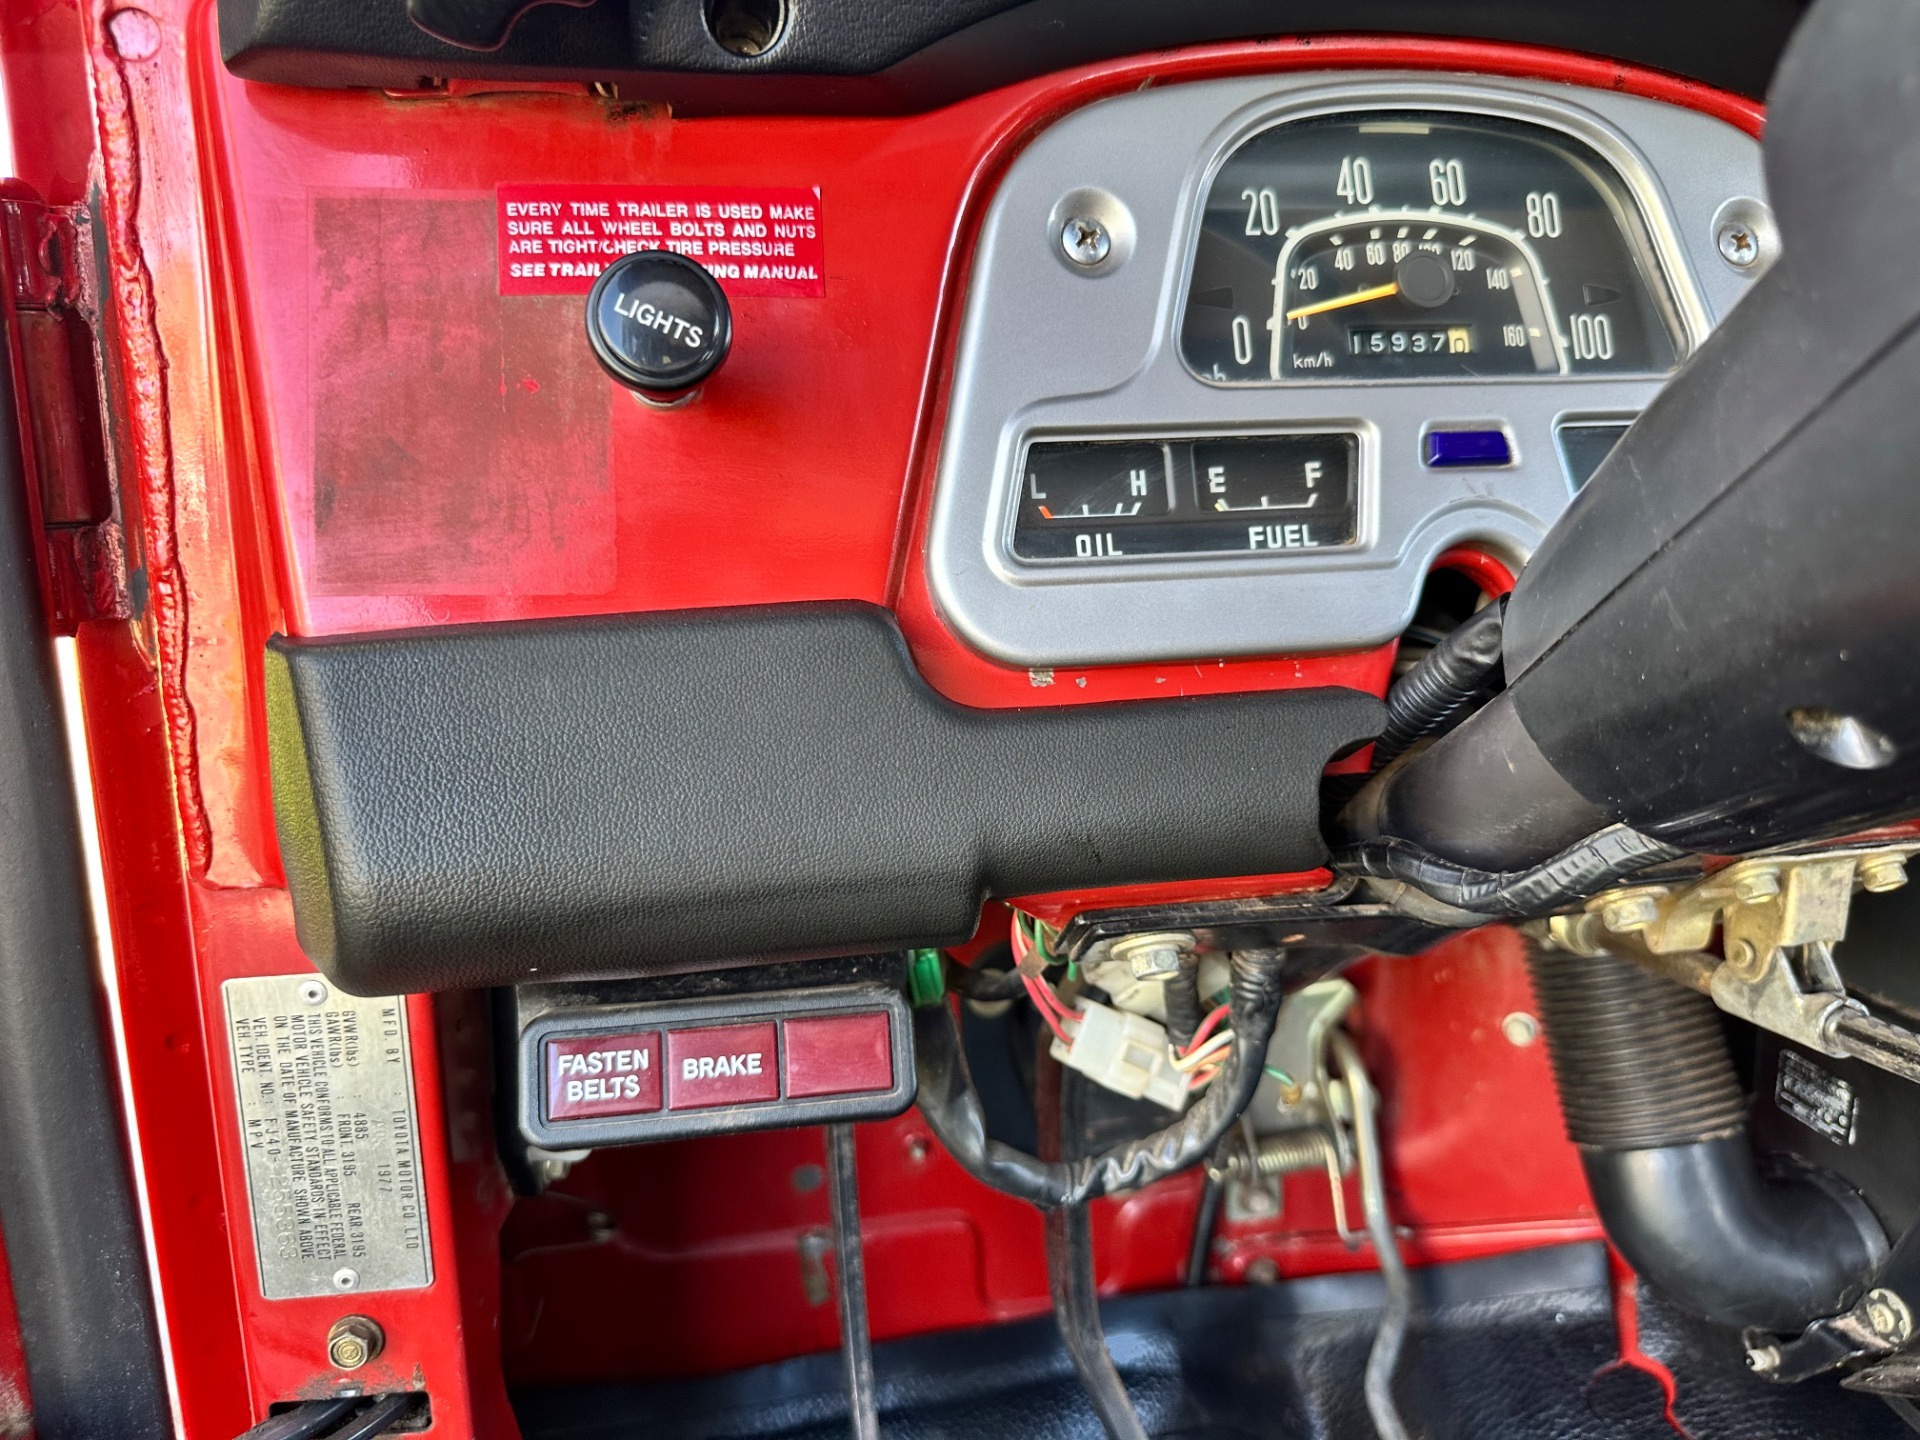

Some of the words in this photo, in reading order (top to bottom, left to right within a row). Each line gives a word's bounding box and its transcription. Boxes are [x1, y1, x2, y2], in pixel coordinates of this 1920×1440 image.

[1337, 158, 1373, 205] 40
[1429, 159, 1467, 206] 60
[506, 202, 562, 217] EVERY
[570, 202, 610, 217] TIME
[617, 203, 689, 218] TRAILER
[695, 204, 712, 218] IS
[718, 204, 763, 219] USED
[769, 205, 816, 221] MAKE
[1241, 188, 1280, 236] 20
[1526, 192, 1562, 238] 80
[507, 221, 554, 235] SURE
[561, 221, 595, 236] ALL
[602, 221, 663, 236] WHEEL
[669, 222, 725, 237] BOLTS
[732, 223, 768, 238] AND
[774, 223, 816, 239] NUTS
[508, 240, 544, 254] ARE
[548, 239, 661, 254] TIGHT/CHECK
[665, 241, 705, 255] TIRE
[708, 241, 795, 257] PRESSURE
[1334, 249, 1353, 271] 40
[1366, 244, 1384, 265] 60
[1392, 243, 1409, 264] 80
[1451, 249, 1473, 271] 120
[510, 263, 546, 277] SEE
[549, 263, 609, 278] TRAIL
[744, 265, 818, 280] MANUAL
[1298, 270, 1316, 290] 20
[1486, 269, 1508, 290] 140
[613, 292, 704, 349] LIGHTS
[1232, 316, 1252, 365] 0
[1503, 326, 1525, 347] 160
[1570, 315, 1613, 361] 100
[1293, 353, 1333, 369] km/h
[1030, 473, 1047, 499] L
[1130, 470, 1147, 496] H
[1208, 467, 1226, 493] E
[1304, 462, 1322, 488] F
[1075, 533, 1123, 557] OIL
[1248, 524, 1319, 550] FUEL
[235, 1018, 251, 1041] VEH.
[252, 1017, 268, 1040] VEH.
[273, 1015, 288, 1028] ON
[290, 1014, 307, 1049] MOTOR
[306, 1013, 322, 1034] THIS
[381, 1007, 398, 1040] MFD.
[275, 1036, 291, 1054] THE
[309, 1038, 327, 1076] VEHICLE
[385, 1047, 400, 1063] BY
[238, 1045, 255, 1073] TYPE
[255, 1044, 272, 1077] IDENT.
[558, 1049, 649, 1075] FASTEN
[683, 1053, 762, 1080] BRAKE
[278, 1061, 294, 1086] DATE
[294, 1055, 312, 1097] VEHICLE
[341, 1010, 360, 1067] GVWR(lbs)
[352, 1111, 368, 1139] 4885
[282, 1091, 296, 1104] OF
[324, 1011, 344, 1068] GAWR(lbs)
[340, 1151, 356, 1176] 3195
[567, 1075, 640, 1102] BELTS
[314, 1081, 333, 1130] CONFORMS
[300, 1103, 317, 1141] SAFETY
[391, 1109, 409, 1154] TOYOTA
[284, 1110, 305, 1181] MANUFACTURE
[320, 1133, 334, 1144] TO
[322, 1147, 336, 1164] ALL
[305, 1146, 324, 1203] STANDARDS
[377, 1163, 392, 1193] 1977
[396, 1159, 414, 1198] MOTOR
[324, 1167, 343, 1218] APPLICABLE
[293, 1188, 310, 1224] SHOWN
[312, 1207, 326, 1218] IN
[298, 1229, 315, 1263] ABOVE.
[314, 1224, 331, 1260] EFFECT
[330, 1221, 347, 1259] FEDERAL
